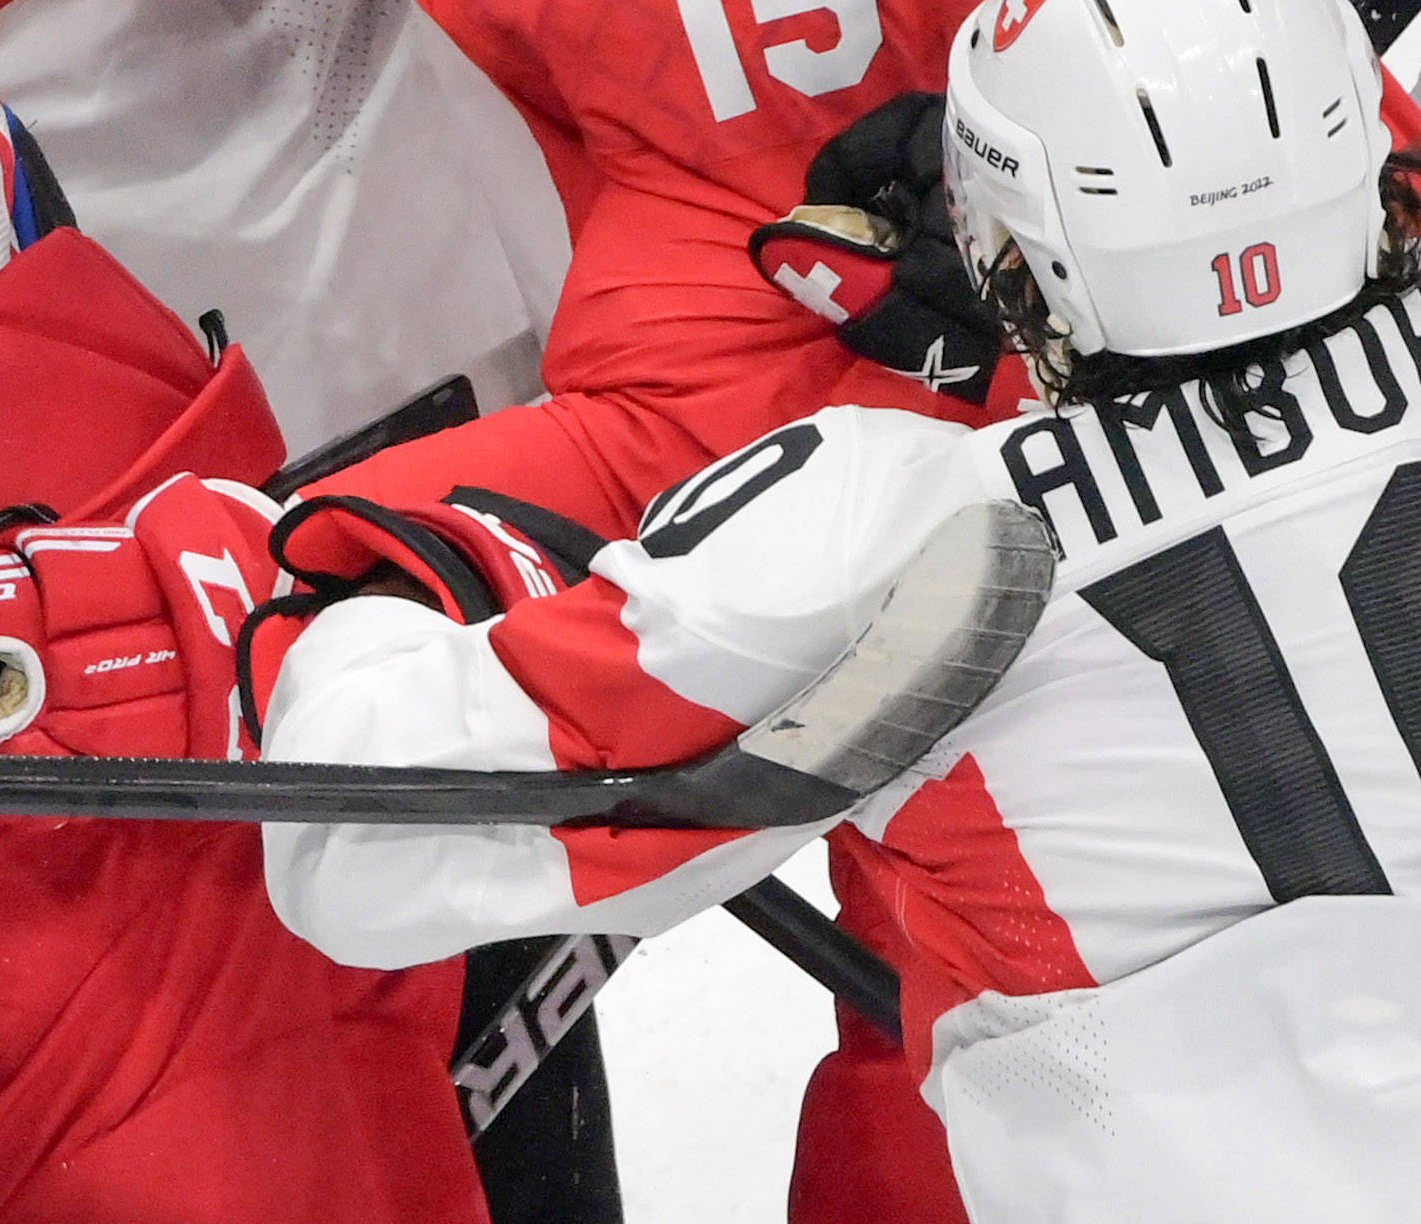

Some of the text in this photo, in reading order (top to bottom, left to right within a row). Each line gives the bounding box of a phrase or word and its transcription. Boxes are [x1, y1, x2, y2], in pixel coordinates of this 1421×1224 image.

[956, 118, 1019, 178] BAUER
[1189, 176, 1274, 206] BEIJING 2022
[1211, 242, 1281, 317] 10
